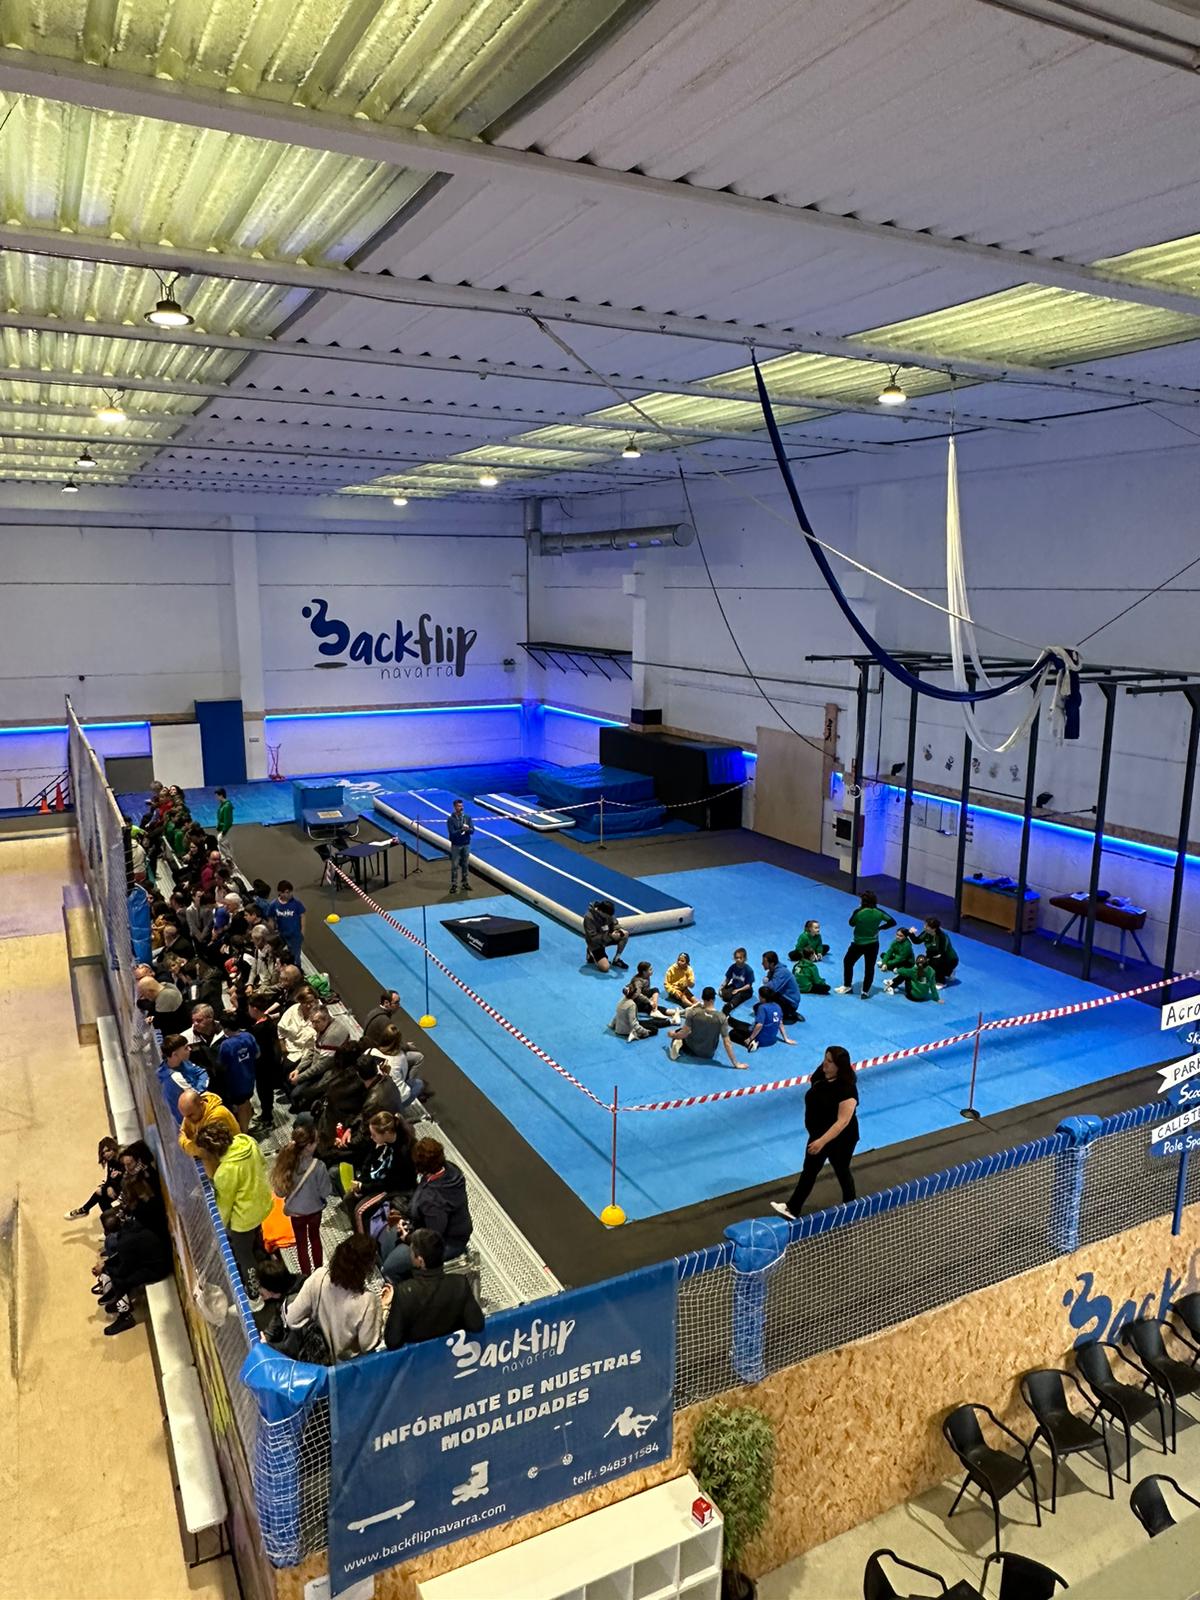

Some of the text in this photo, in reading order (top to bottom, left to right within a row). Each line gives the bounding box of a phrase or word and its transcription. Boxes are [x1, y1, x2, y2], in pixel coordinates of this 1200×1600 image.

[302, 599, 477, 677] Backflip
[381, 665, 453, 680] navarra
[1163, 1138, 1184, 1155] Pole
[446, 1318, 576, 1368] Backflip
[502, 1346, 555, 1375] navarra
[374, 1350, 642, 1452] INFÓRMATE DE NUESTRAS
[441, 1388, 590, 1452] MODALIDADES
[600, 1442, 660, 1476] 948311584
[343, 1503, 507, 1573] www.backflipnavarra.com
